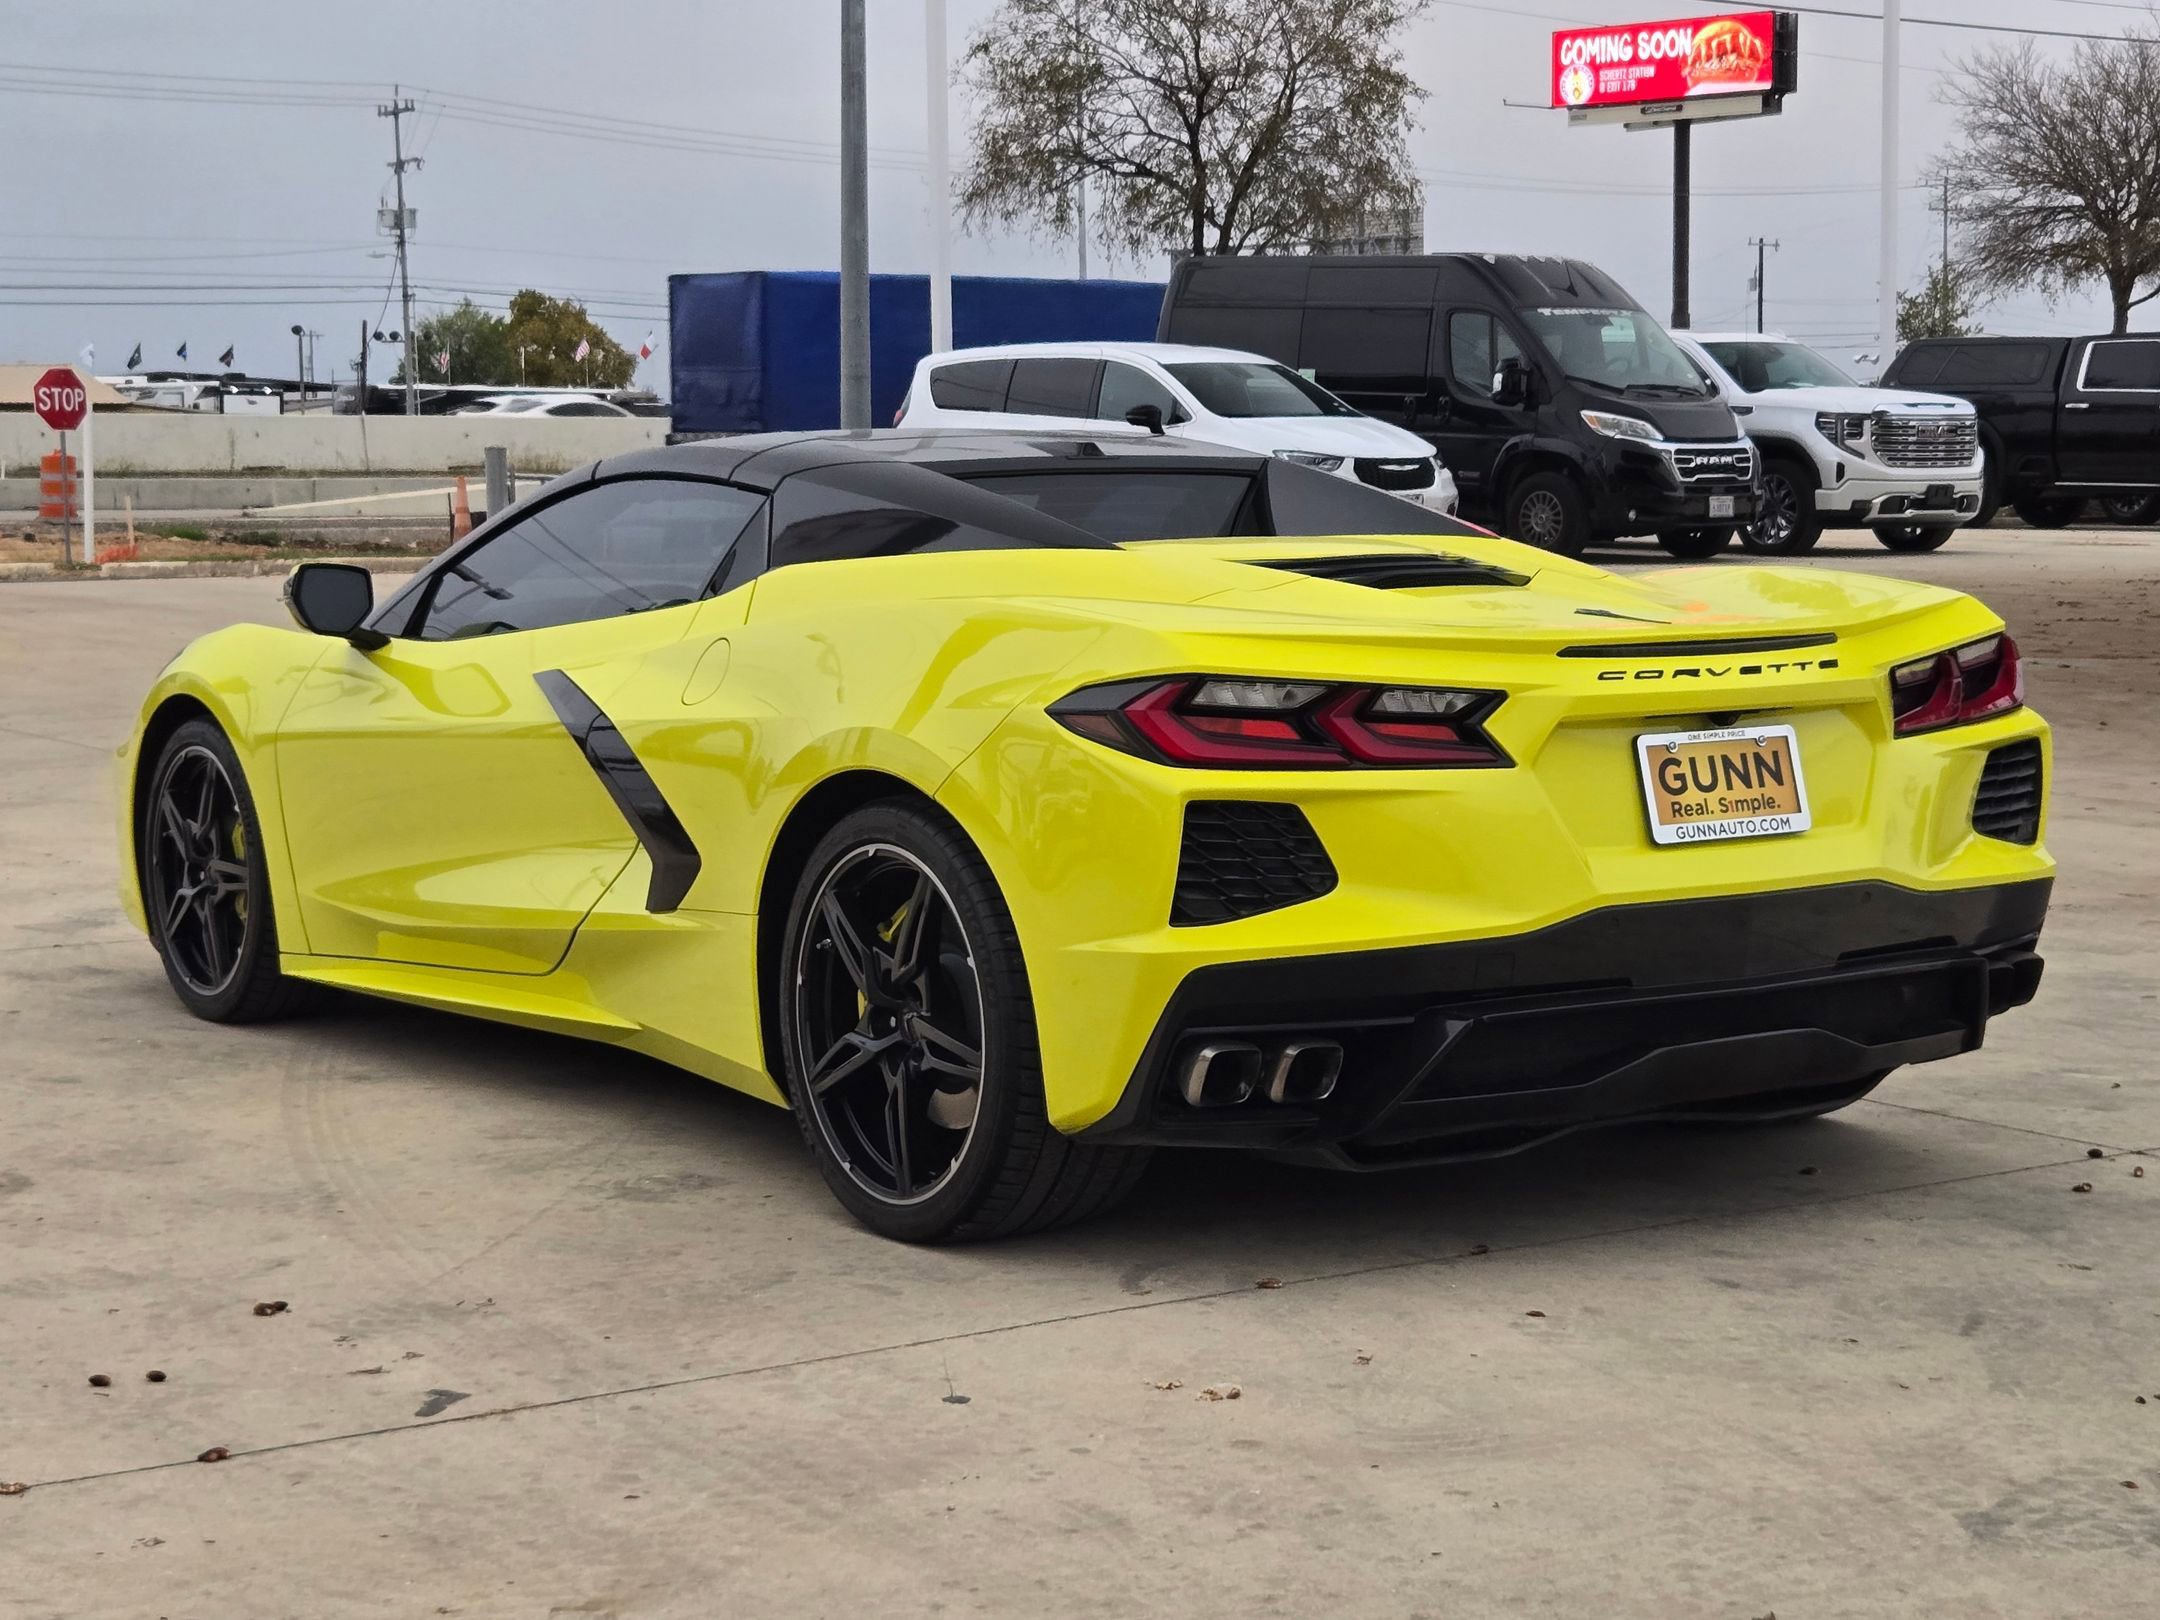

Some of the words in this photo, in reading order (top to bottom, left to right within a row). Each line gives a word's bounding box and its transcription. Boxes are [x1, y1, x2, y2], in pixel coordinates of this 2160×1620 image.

[1560, 33, 1633, 66] COMING
[1637, 28, 1693, 61] SOON
[1628, 66, 1655, 79] STATION
[1607, 80, 1621, 93] EXIT
[38, 387, 85, 412] STOP
[1695, 456, 1733, 465] RAM
[1597, 658, 1839, 681] CORVETTE
[1687, 733, 1702, 741] ONE
[1703, 731, 1726, 740] SIMPLE
[1727, 729, 1746, 738] PRICE
[1657, 750, 1785, 796] GUNN
[1670, 799, 1715, 819] Real.
[1675, 817, 1792, 840] GUNNAUTO.COM
